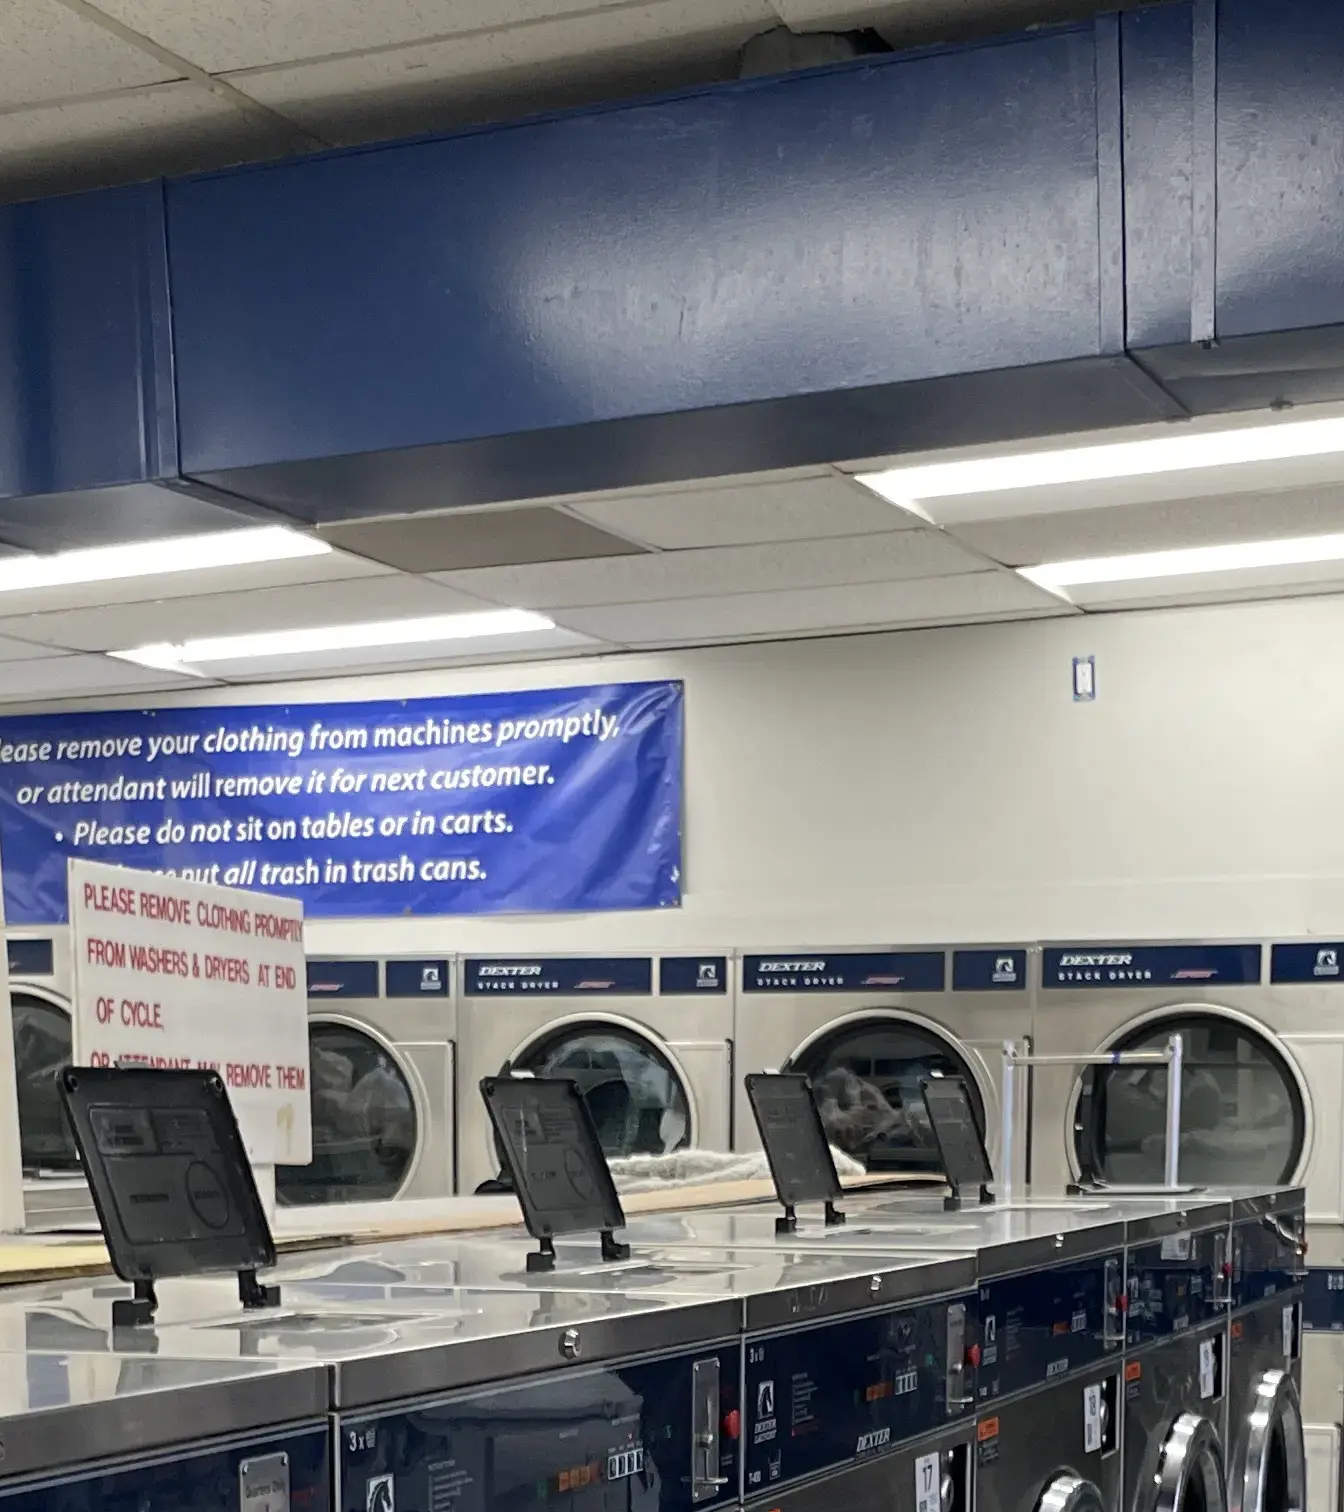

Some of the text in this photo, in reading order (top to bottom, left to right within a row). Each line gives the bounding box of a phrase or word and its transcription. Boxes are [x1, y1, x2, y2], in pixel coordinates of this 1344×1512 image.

[57, 737, 141, 760] remove
[147, 734, 196, 763] your
[203, 726, 305, 757] clothing
[311, 724, 367, 750] from
[374, 719, 492, 748] machines
[496, 709, 619, 747] promptly,
[17, 763, 555, 804] or attendant will remove it for next customer.
[73, 811, 514, 846] Please do not sit on tables or in carts.
[223, 860, 258, 886] all
[260, 857, 320, 886] trash
[324, 859, 348, 883] in
[352, 855, 416, 883] trash
[419, 857, 488, 882] cans.
[84, 883, 136, 916] PLEASE
[140, 892, 191, 925] REMOVE
[197, 901, 251, 936] CLOTHING
[87, 938, 297, 990] FROM WASHERS & DRYERS AT END
[479, 965, 542, 977] DEXTER
[758, 960, 827, 973] DEXTER
[1059, 952, 1134, 967] DEXTER
[96, 997, 115, 1025] OF
[225, 1063, 272, 1089] REMOVE
[277, 1065, 306, 1091] THEM
[349, 1431, 357, 1452] 3
[856, 1427, 891, 1453] DEXTER
[922, 1463, 934, 1493] 17
